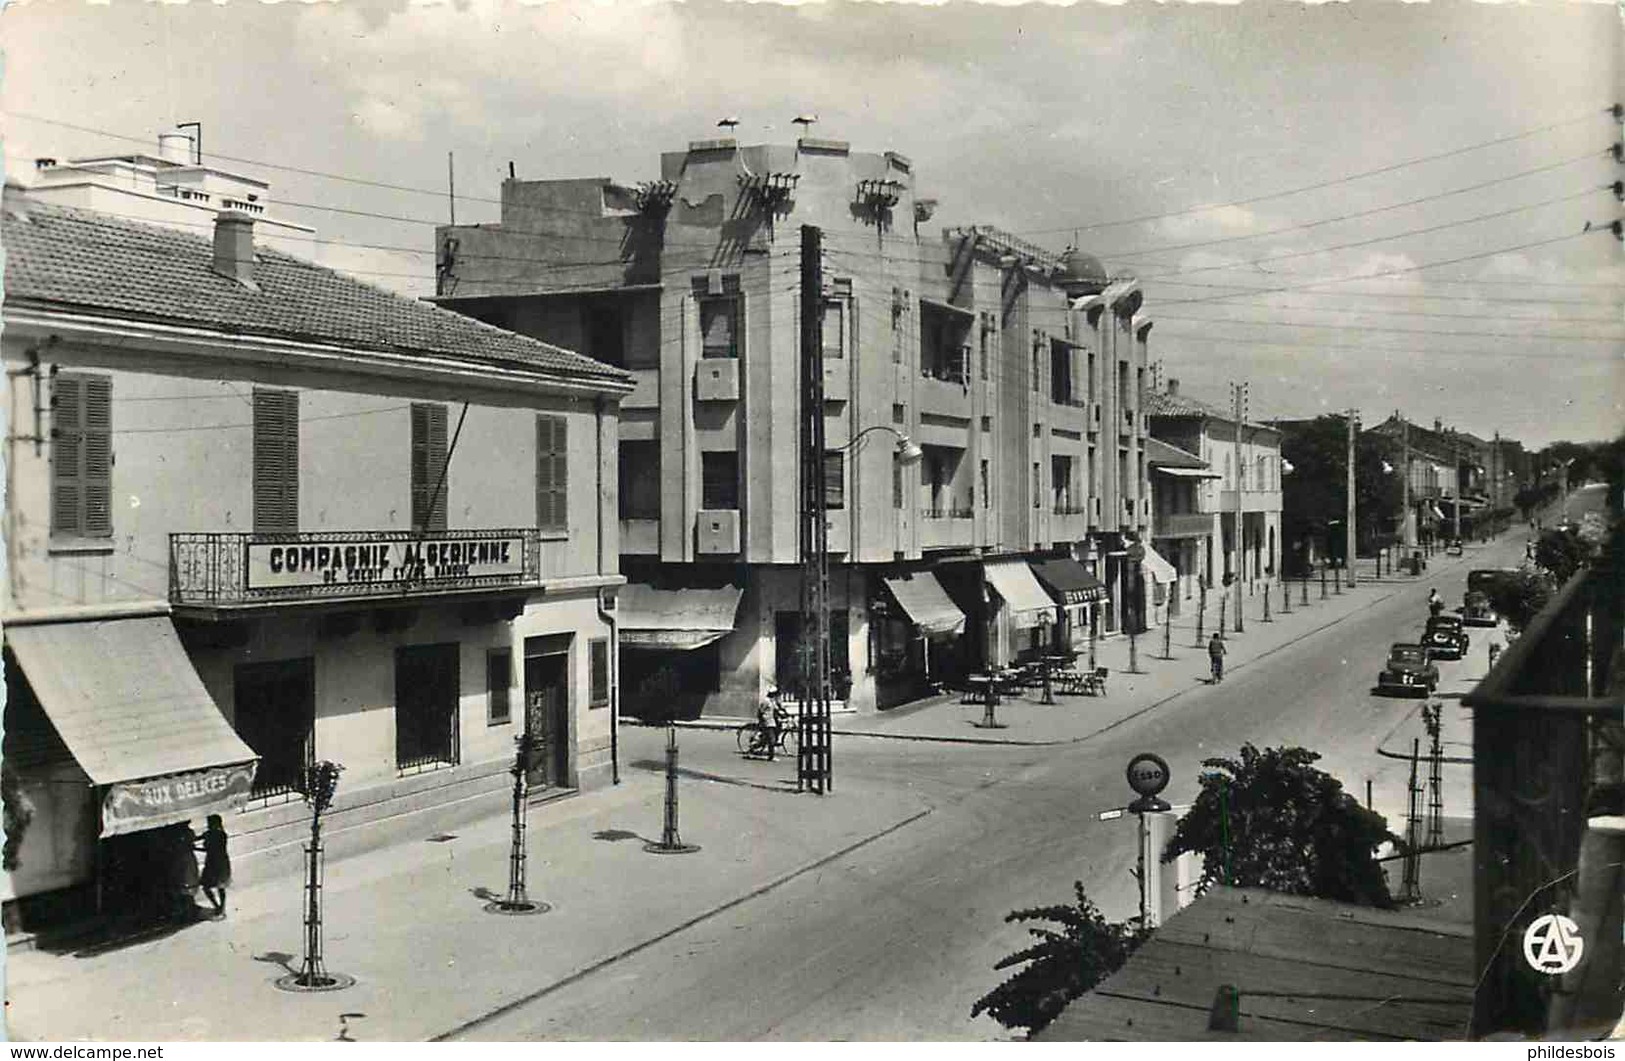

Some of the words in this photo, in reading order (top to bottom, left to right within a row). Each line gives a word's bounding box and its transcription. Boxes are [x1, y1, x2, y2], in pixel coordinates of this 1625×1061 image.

[270, 545, 390, 573] COMPAGNIE
[404, 541, 510, 567] ALGERIENNE
[323, 570, 337, 583] DE
[141, 785, 173, 804] AUX
